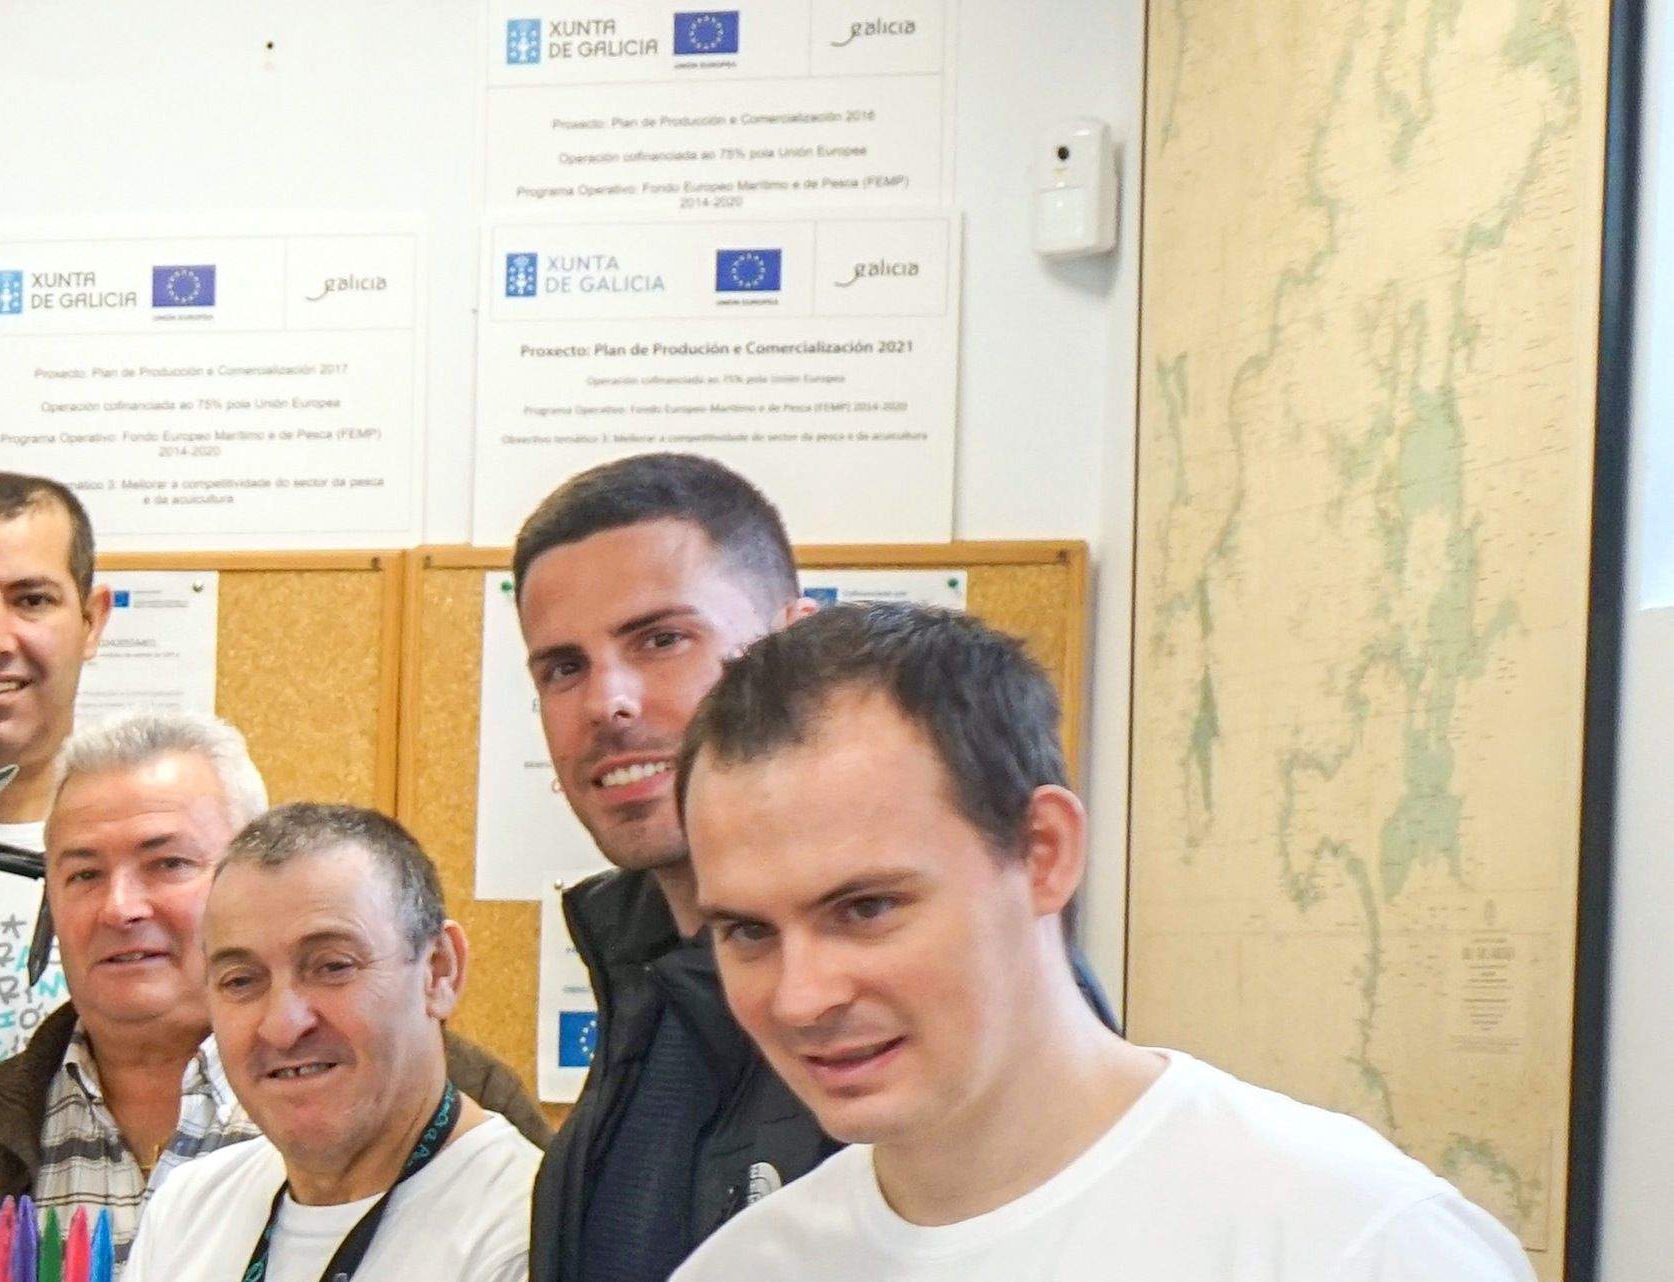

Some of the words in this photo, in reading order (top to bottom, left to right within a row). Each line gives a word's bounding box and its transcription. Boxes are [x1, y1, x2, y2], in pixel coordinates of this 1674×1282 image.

[549, 19, 615, 37] XUNTA
[549, 41, 572, 59] DE
[578, 39, 658, 57] GALICIA
[548, 254, 619, 272] XUNTA
[32, 272, 95, 288] XUNTA
[544, 276, 571, 293] DE
[579, 275, 665, 293] GALICIA
[31, 293, 54, 309] DE
[60, 292, 137, 309] GALICIA
[520, 344, 590, 357] Proxecto:
[592, 343, 627, 356] Plan
[629, 343, 649, 356] de
[745, 340, 873, 354] Comercialización
[875, 340, 913, 353] 2021
